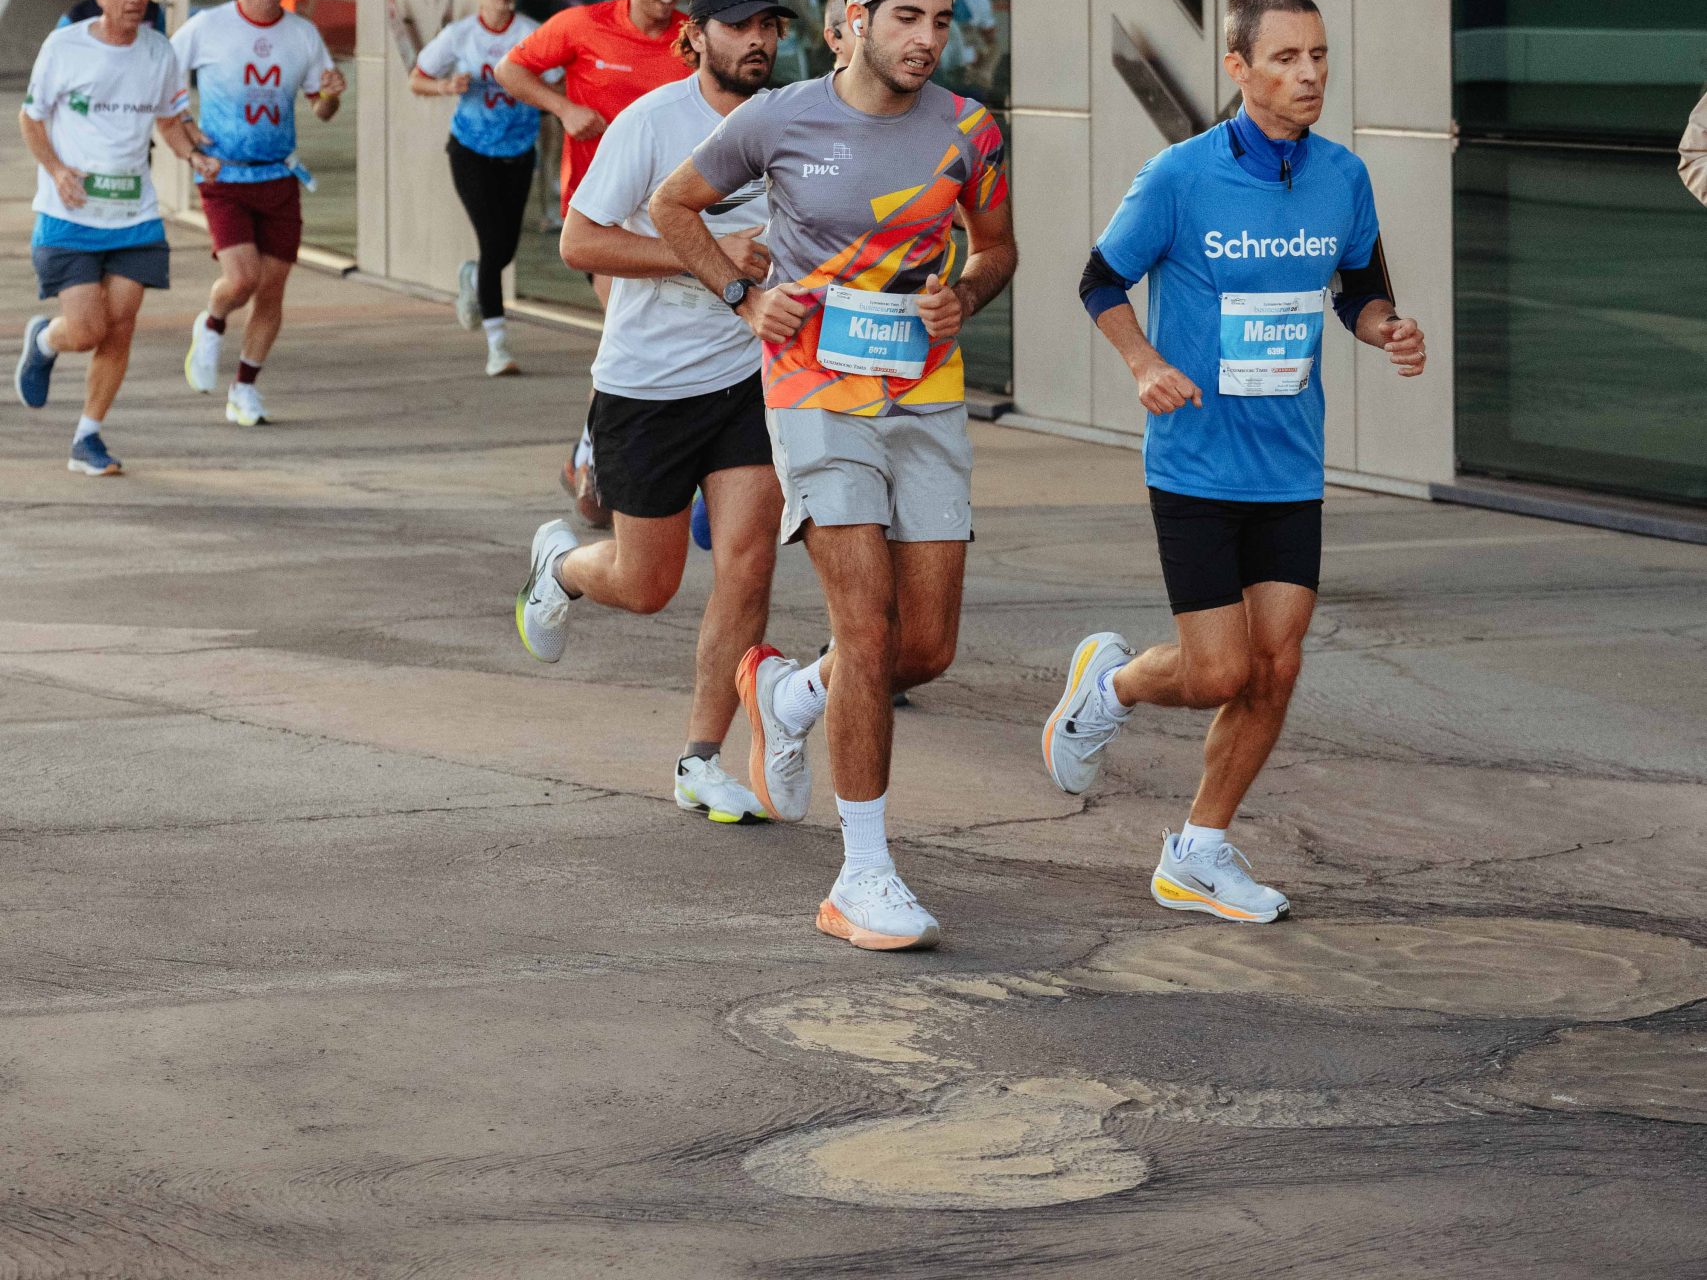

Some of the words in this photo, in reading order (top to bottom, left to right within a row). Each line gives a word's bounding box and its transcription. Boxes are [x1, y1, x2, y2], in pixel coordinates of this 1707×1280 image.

[802, 163, 840, 178] pwc
[1204, 228, 1338, 259] Schroders
[848, 316, 911, 342] Khalil
[1243, 320, 1308, 342] Marco
